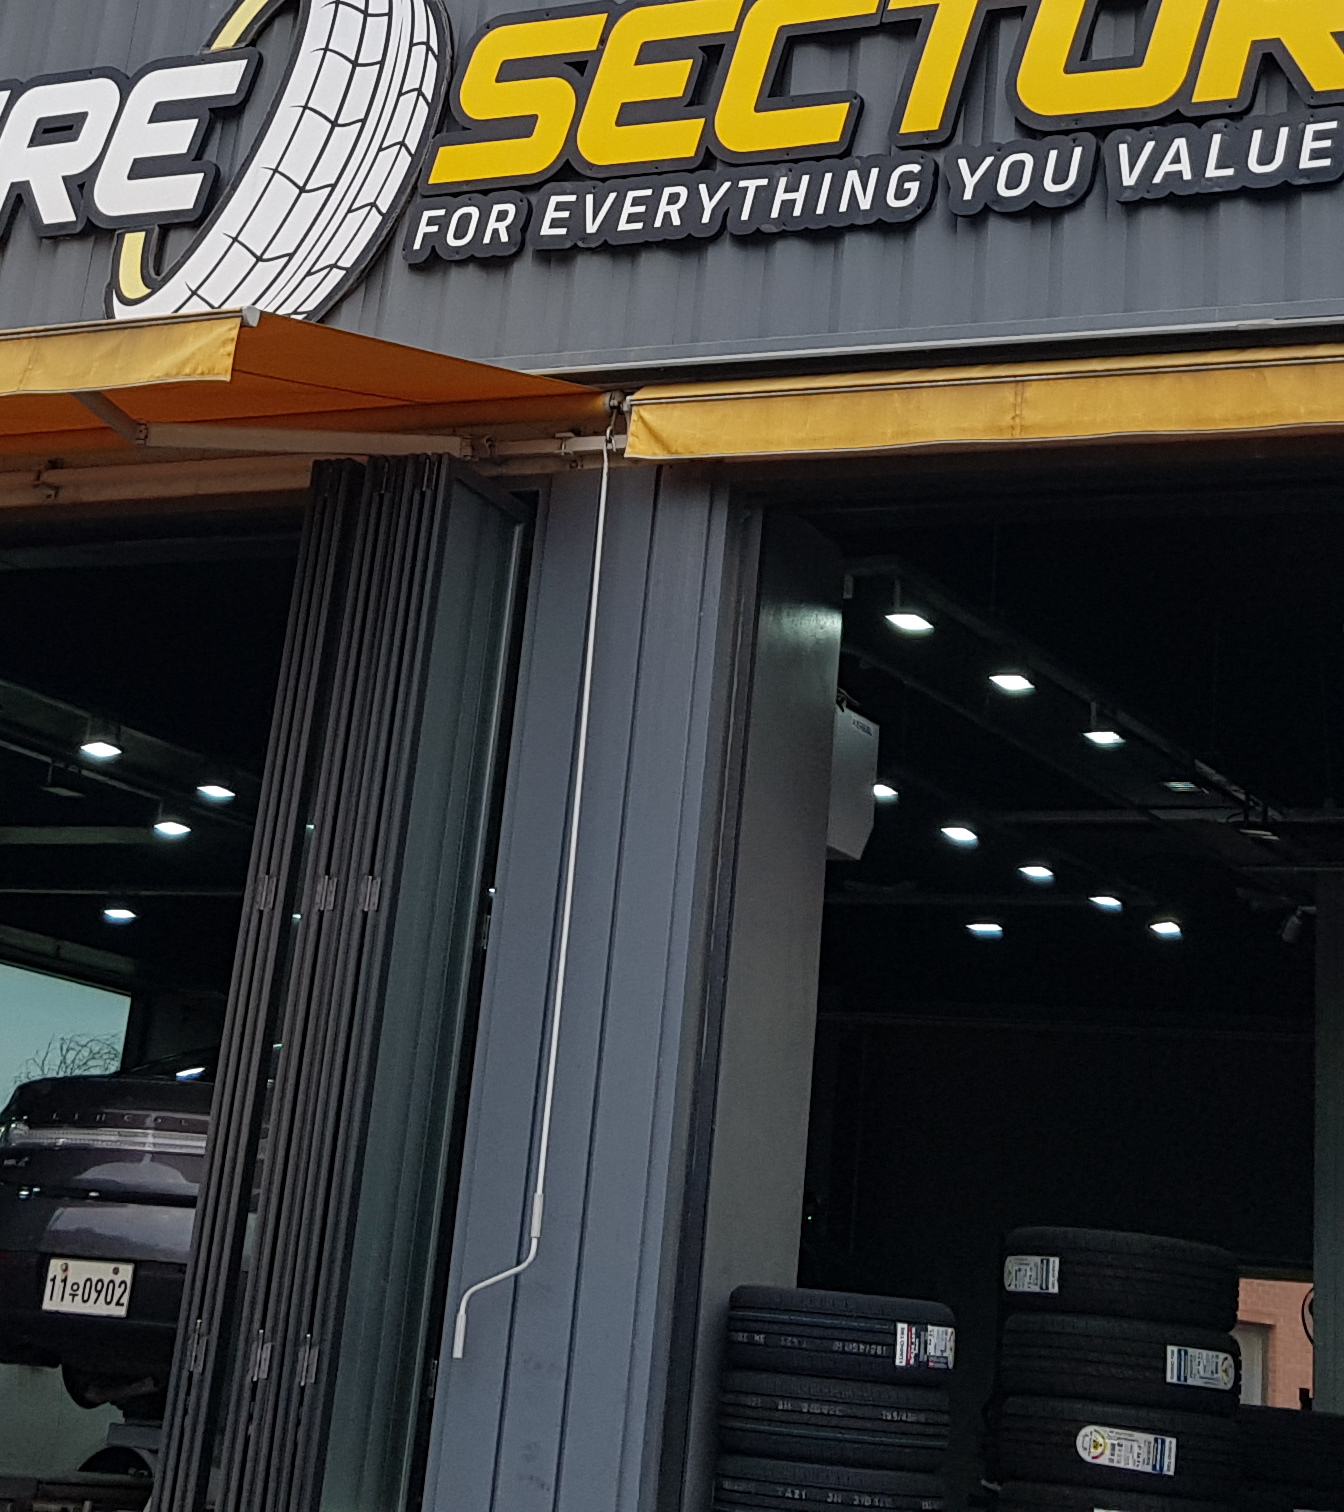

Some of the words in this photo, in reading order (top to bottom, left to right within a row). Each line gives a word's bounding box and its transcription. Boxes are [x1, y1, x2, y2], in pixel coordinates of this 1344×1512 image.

[412, 202, 517, 252] FOR
[539, 162, 922, 237] EVERYTHING
[957, 144, 1085, 201] YOU
[1117, 119, 1341, 187] VALUE
[49, 1274, 128, 1307] 11우0902
